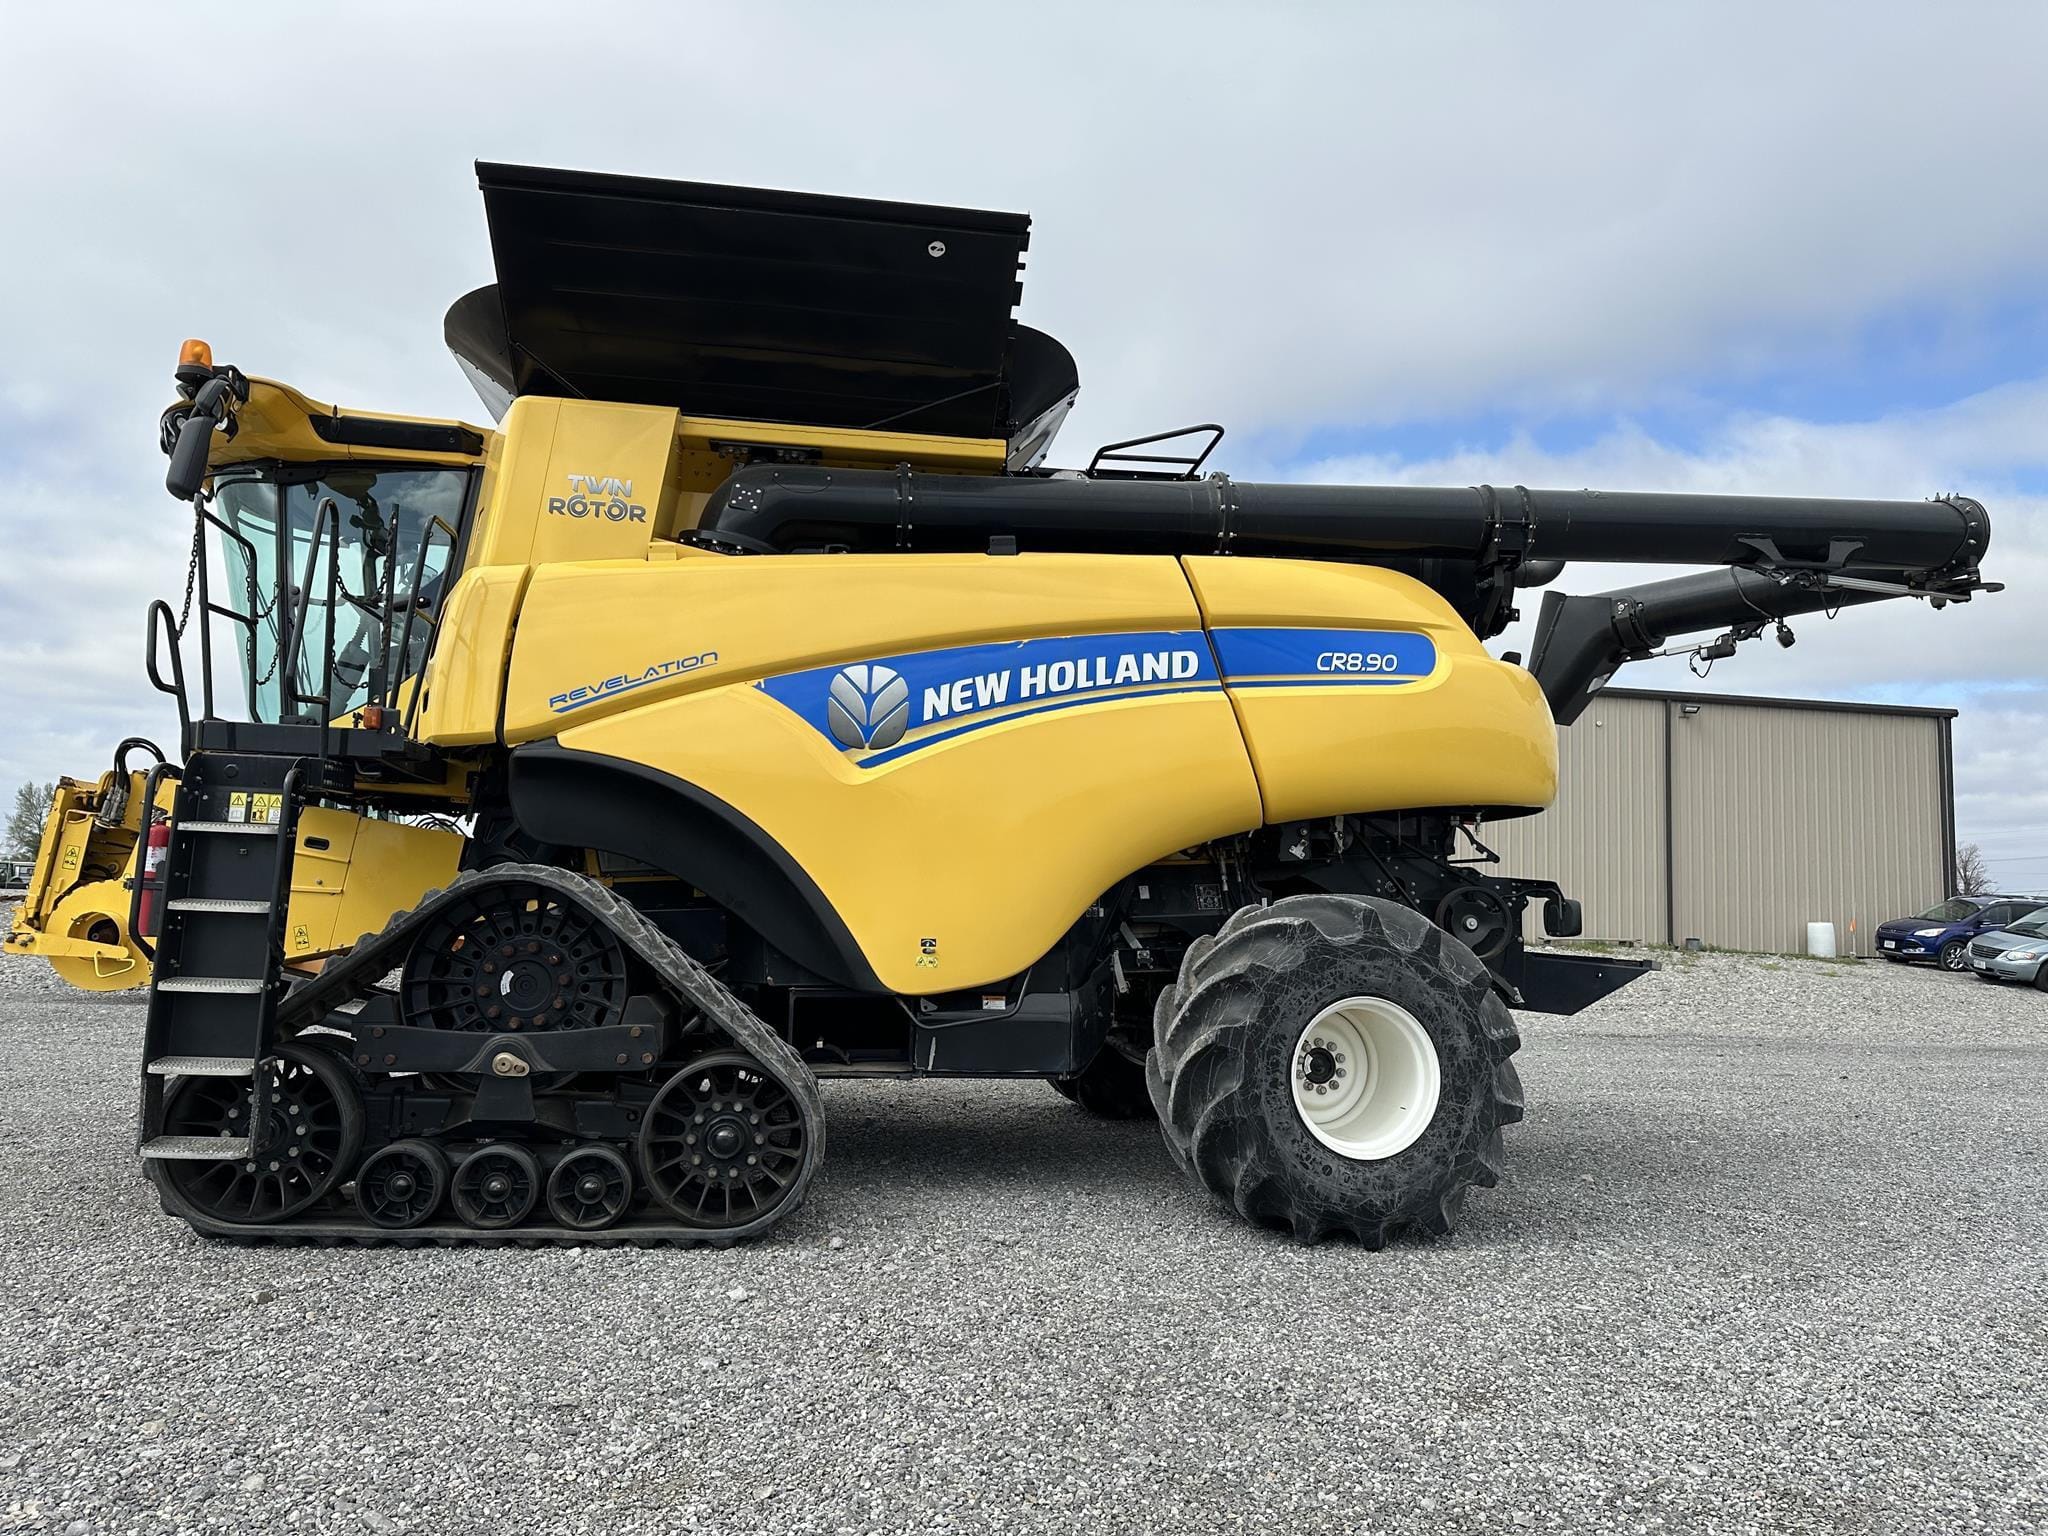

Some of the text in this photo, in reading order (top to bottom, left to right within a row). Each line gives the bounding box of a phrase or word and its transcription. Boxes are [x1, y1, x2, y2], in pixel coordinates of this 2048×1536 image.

[567, 474, 632, 498] TWIN
[548, 493, 646, 523] ROTOR
[1316, 652, 1398, 672] CR8.90
[549, 651, 718, 708] REVELATION
[923, 650, 1199, 721] NEW HOLLAND
